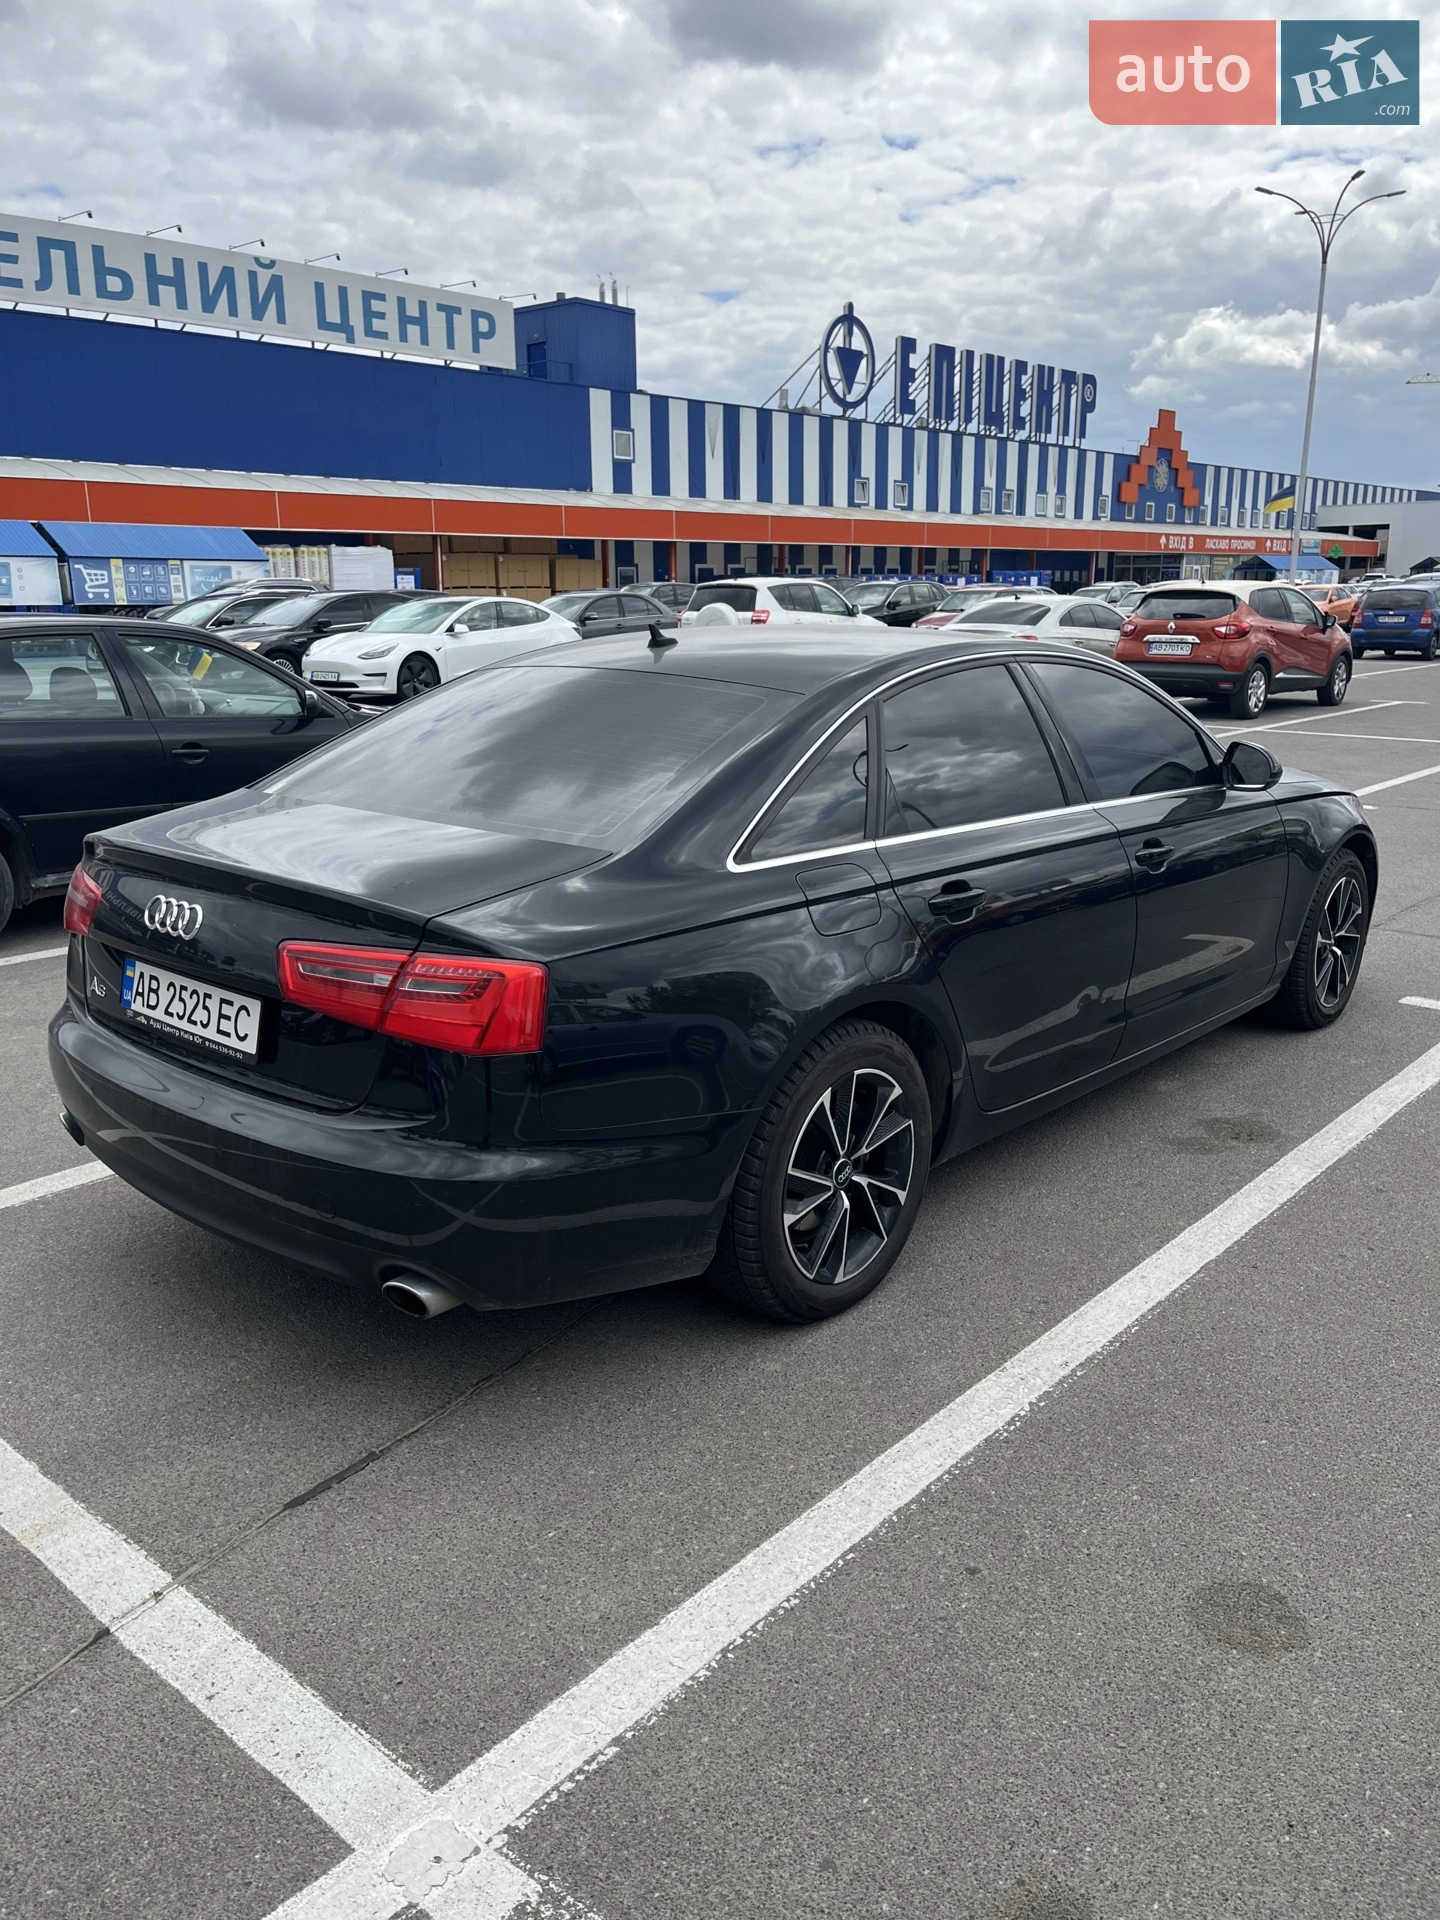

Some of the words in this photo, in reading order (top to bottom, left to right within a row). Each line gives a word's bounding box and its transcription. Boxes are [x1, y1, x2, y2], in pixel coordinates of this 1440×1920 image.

[314, 281, 497, 355] ЦЕНТР
[895, 335, 1098, 439] ЕПІЦЕНТР
[1169, 535, 1187, 551] ВХІД
[1189, 536, 1194, 549] В
[1205, 538, 1229, 550] ЛАСКАВО
[1230, 539, 1256, 551] ПРОСИМО!
[1272, 539, 1287, 553] ВХІД
[1154, 643, 1163, 652] AB
[1163, 644, 1180, 652] 2703
[90, 976, 107, 998] A6
[123, 988, 132, 1002] UA
[133, 971, 160, 1011] AB
[163, 981, 212, 1029] 2525
[216, 997, 251, 1042] EC
[162, 1023, 179, 1037] Центр
[180, 1031, 193, 1041] Київ
[194, 1035, 203, 1045] Юг
